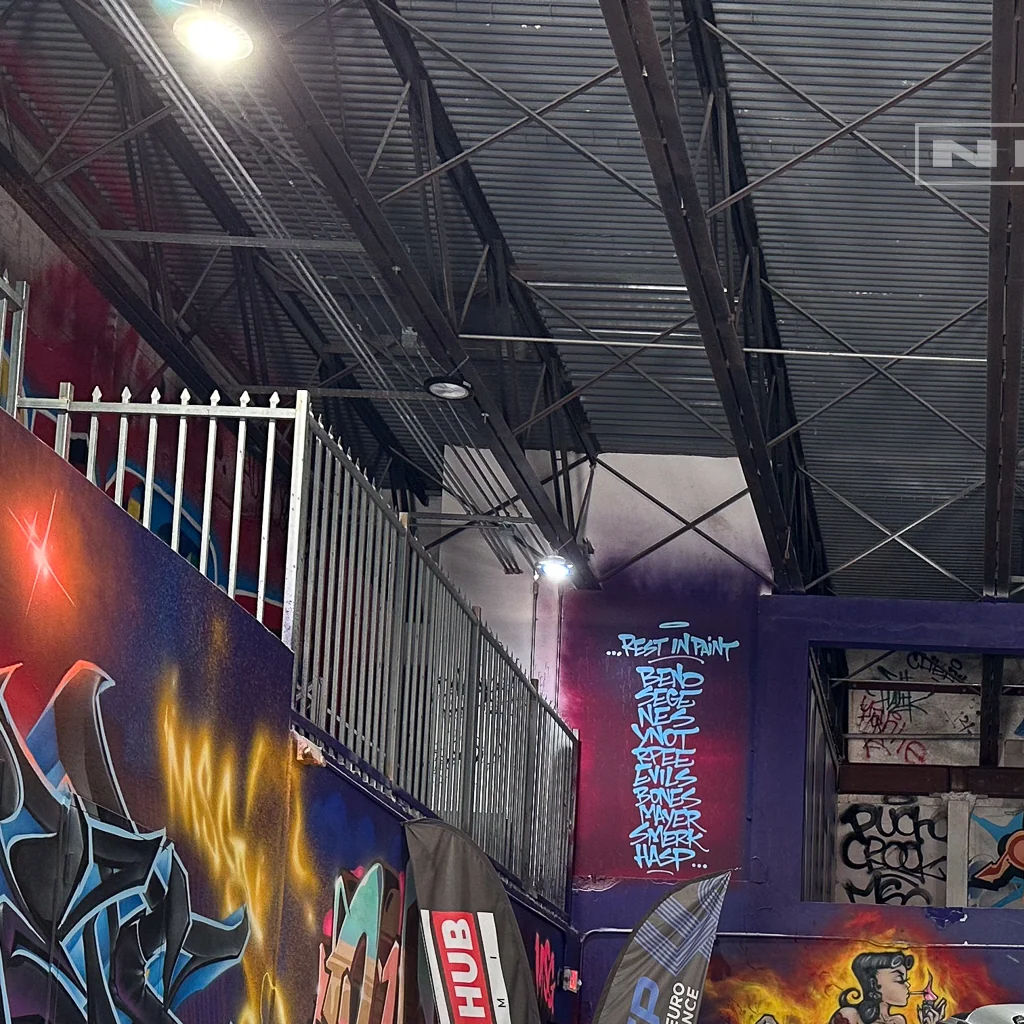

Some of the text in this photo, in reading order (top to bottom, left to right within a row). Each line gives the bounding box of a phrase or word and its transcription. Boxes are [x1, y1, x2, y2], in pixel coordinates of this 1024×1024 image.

[671, 633, 690, 656] IN
[692, 635, 740, 661] PAINT
[638, 705, 696, 728] NES
[631, 723, 700, 749] YNOT
[632, 764, 697, 788] EVILS
[633, 786, 702, 808] BONES
[639, 805, 708, 833] MAYER
[441, 918, 487, 1018] HUB
